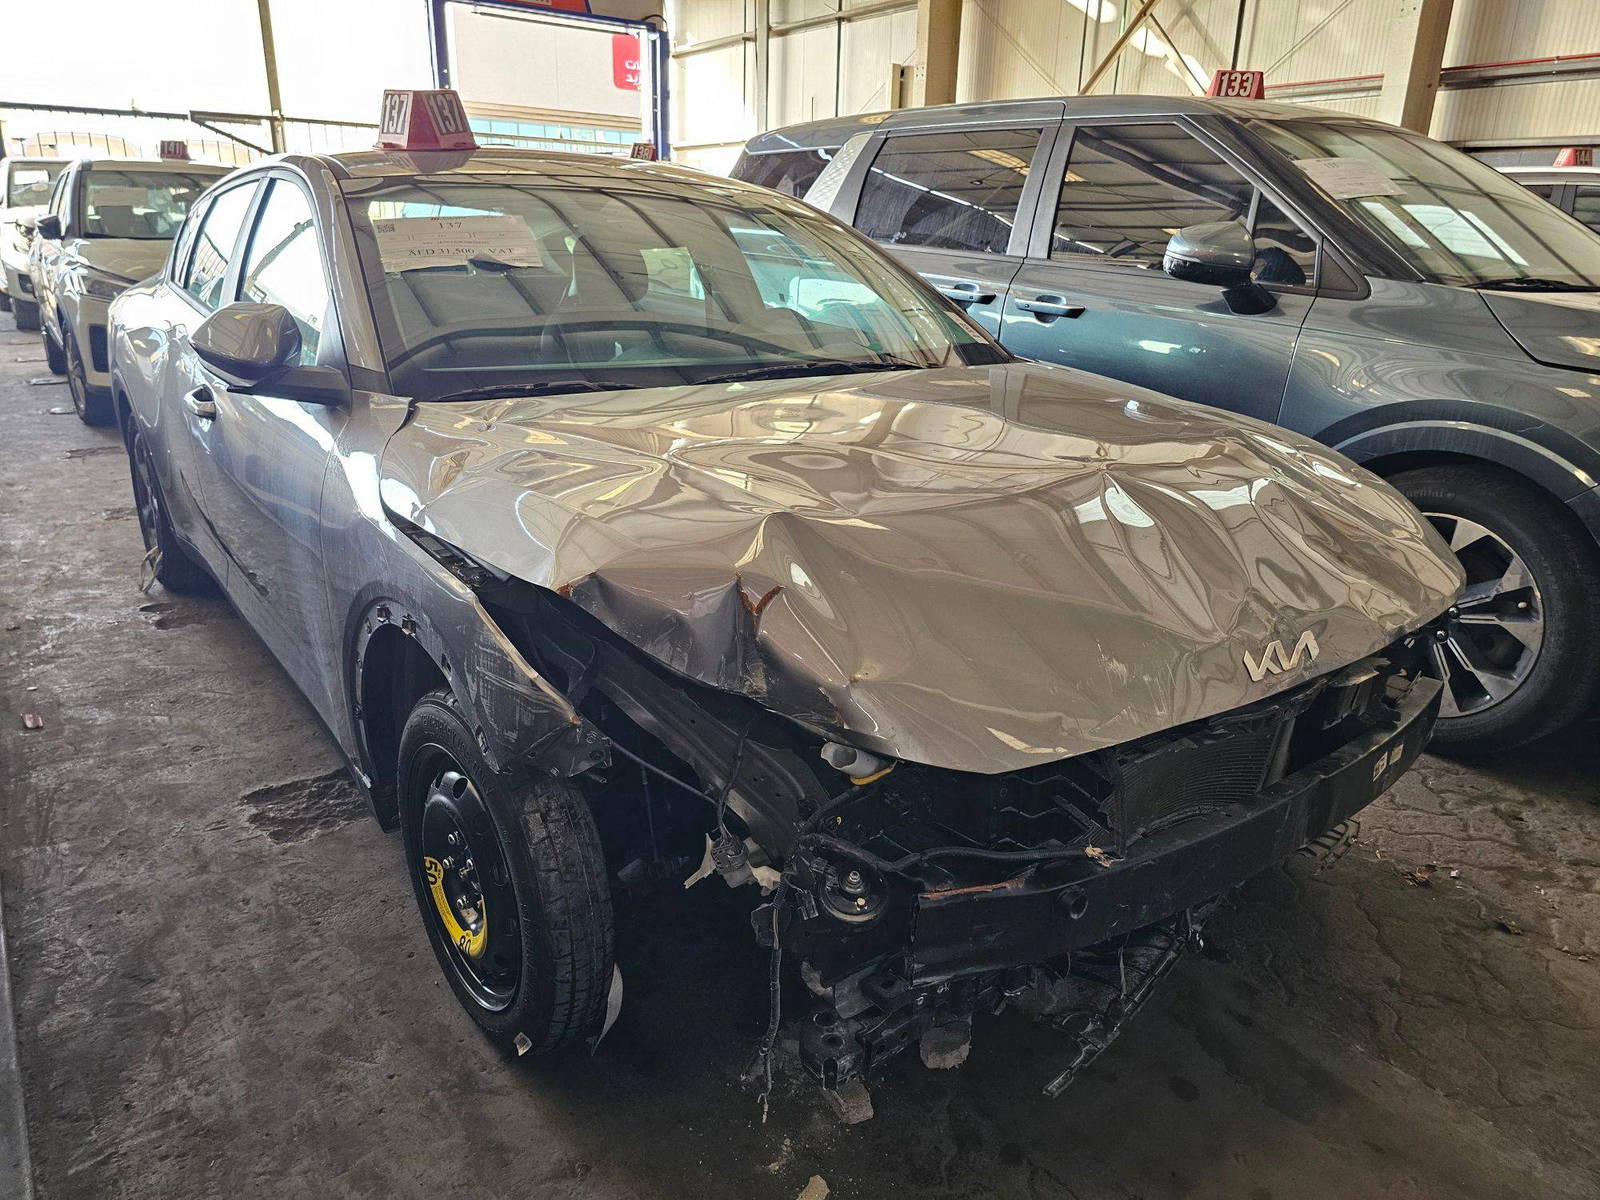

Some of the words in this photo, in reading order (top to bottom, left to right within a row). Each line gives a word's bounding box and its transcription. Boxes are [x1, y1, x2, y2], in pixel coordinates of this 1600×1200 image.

[1220, 72, 1253, 97] 133
[383, 94, 408, 133] 137
[430, 92, 464, 134] 137
[439, 221, 462, 229] 137
[408, 248, 435, 257] AED
[1243, 630, 1320, 682] KIA
